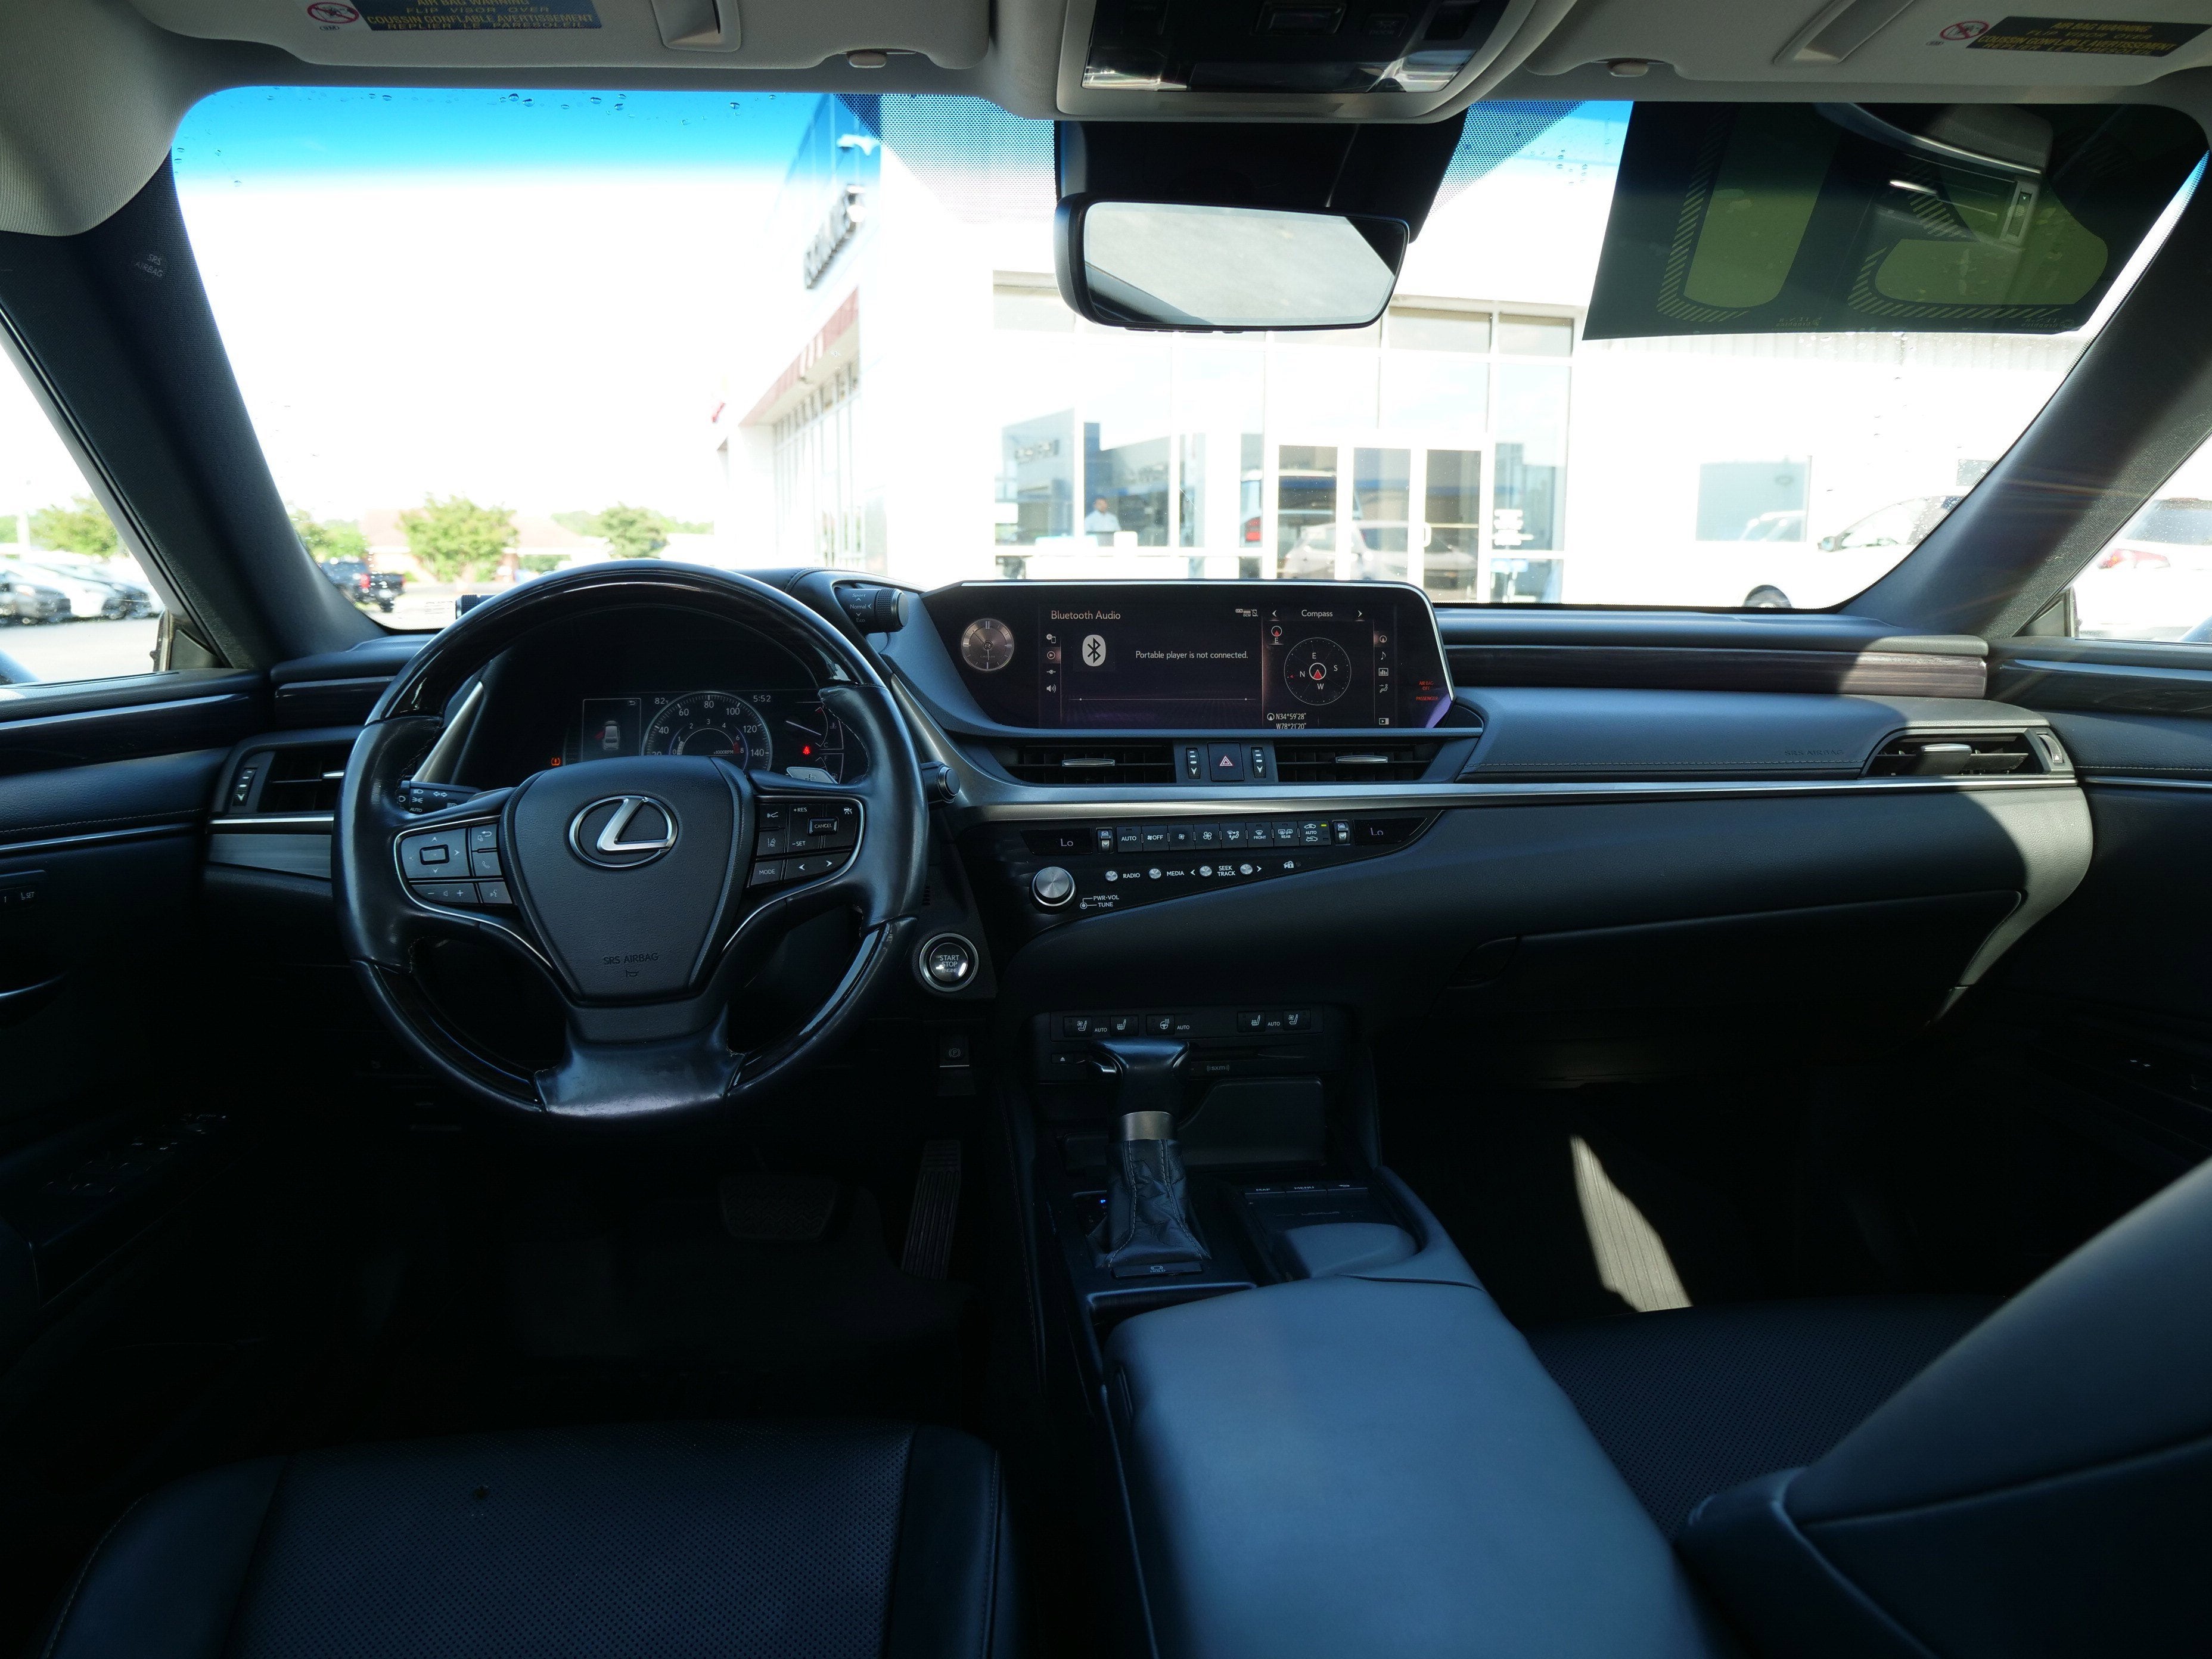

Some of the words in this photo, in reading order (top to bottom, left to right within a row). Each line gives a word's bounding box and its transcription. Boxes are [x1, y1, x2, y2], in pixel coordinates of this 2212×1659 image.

[1052, 611, 1093, 620] Bluetooth
[1095, 611, 1121, 620] Audio
[1301, 610, 1333, 619] Compass
[1166, 651, 1186, 660] player
[726, 707, 740, 716] 100
[1370, 827, 1384, 835] Lo
[1060, 838, 1074, 847] Lo
[604, 956, 621, 965] SRS
[623, 952, 659, 964] AIRBAG
